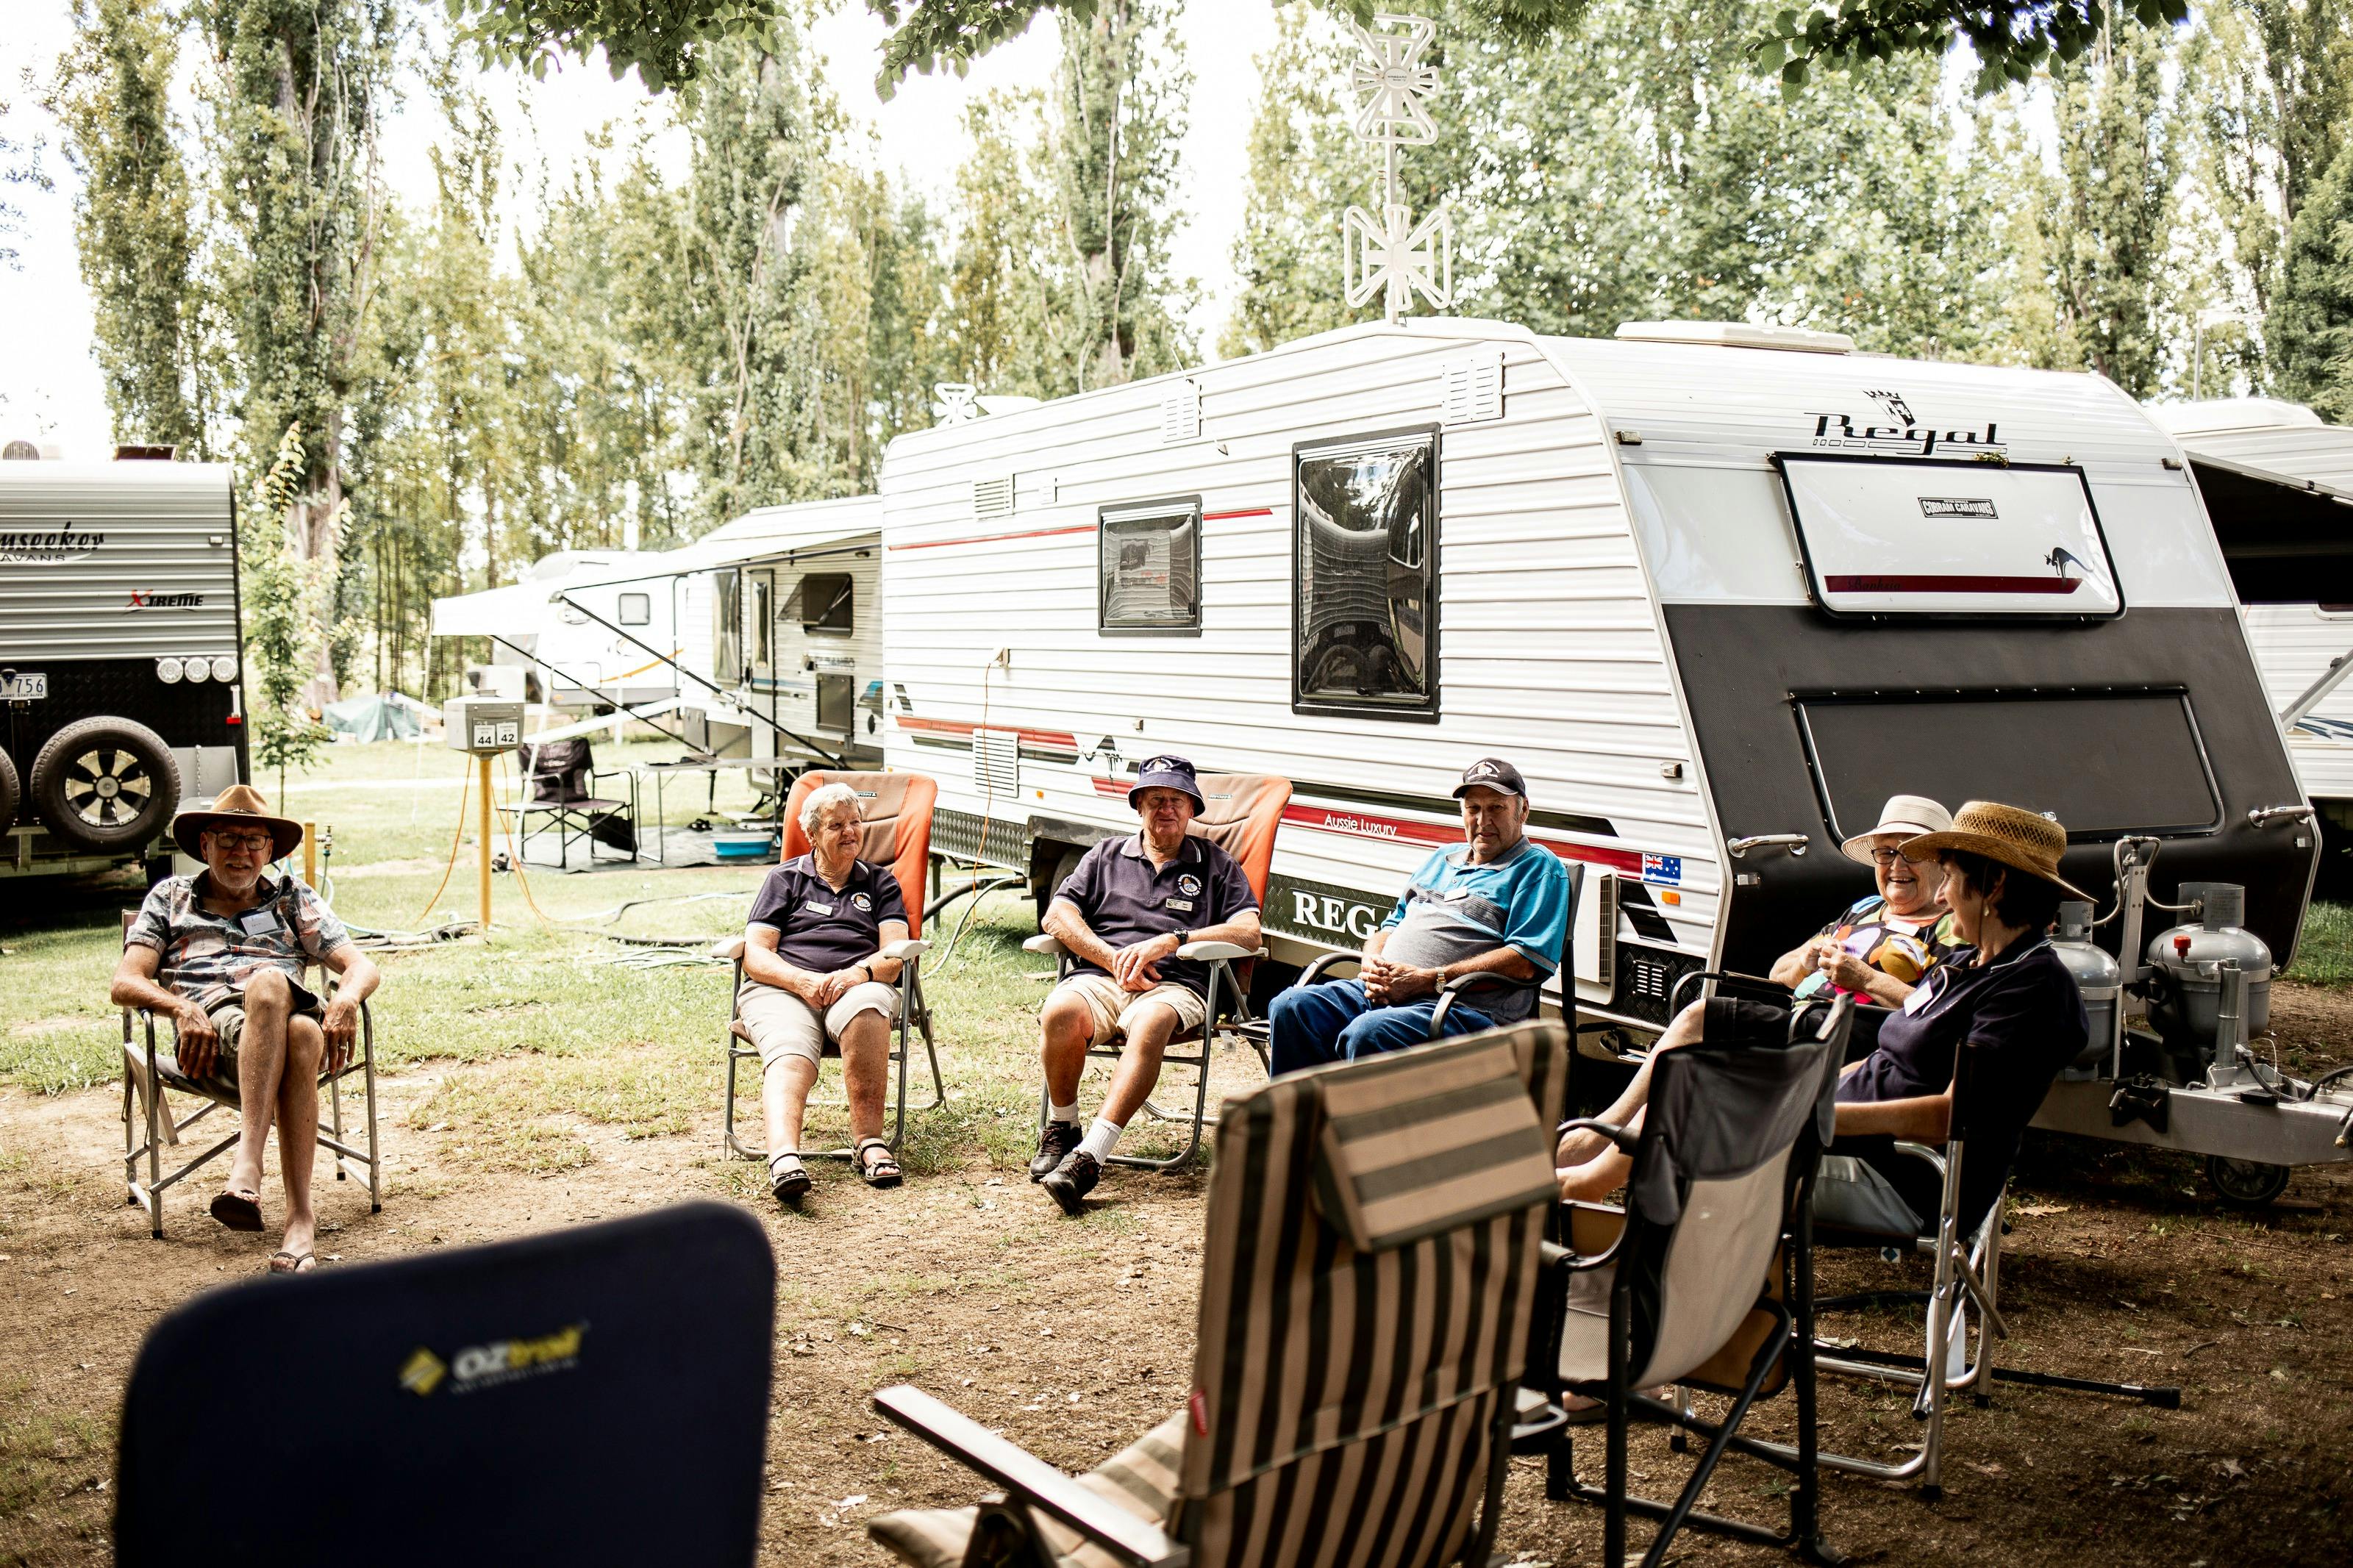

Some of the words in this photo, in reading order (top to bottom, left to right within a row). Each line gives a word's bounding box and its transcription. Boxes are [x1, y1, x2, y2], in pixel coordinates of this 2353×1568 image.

[1804, 412, 2007, 455] Regal
[1922, 501, 1955, 514] COBRAM
[1955, 502, 1993, 515] CARAVANS
[478, 736, 491, 744] 44
[501, 734, 515, 742] 42
[1324, 813, 1358, 831] Aussie
[1360, 818, 1397, 837] Luxury
[1293, 891, 1391, 940] REG
